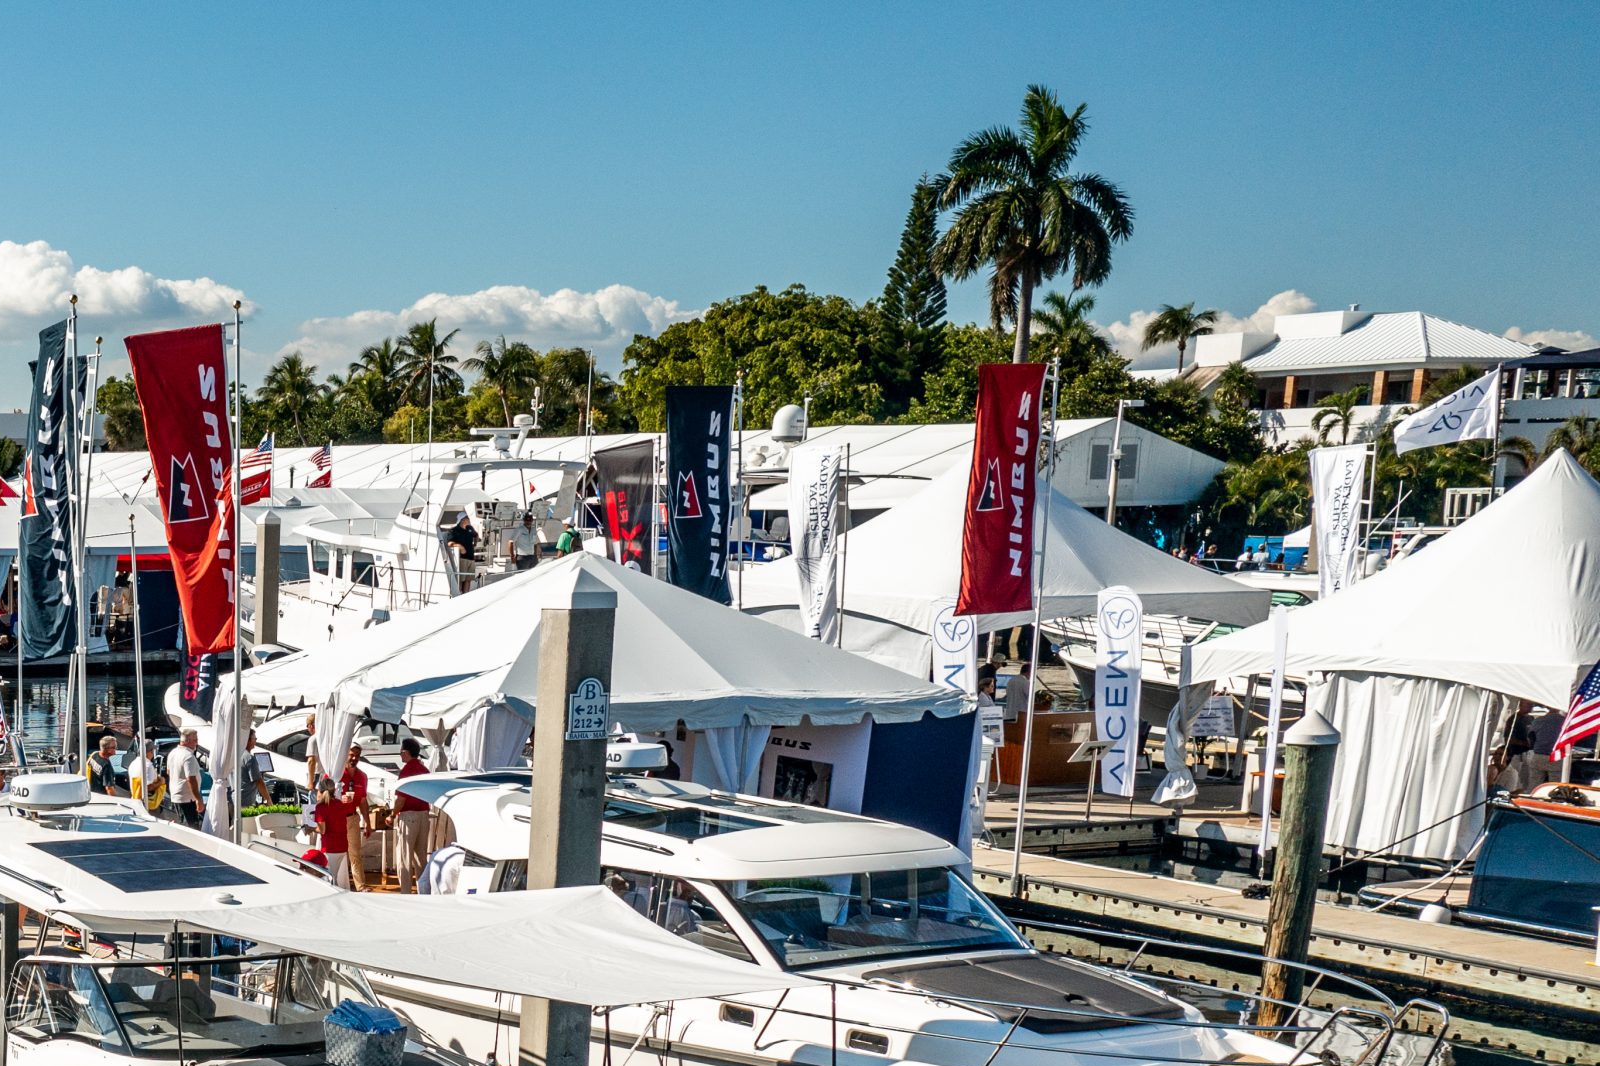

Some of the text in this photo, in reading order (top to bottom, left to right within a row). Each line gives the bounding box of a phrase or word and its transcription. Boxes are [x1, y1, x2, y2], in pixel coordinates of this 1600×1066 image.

[197, 364, 235, 604] NIMBUS
[706, 410, 722, 578] NIMBUS
[1009, 391, 1032, 578] NIMBUS
[809, 482, 819, 533] YACHTS
[1332, 486, 1342, 531] YACHTS
[184, 655, 201, 701] OATS
[584, 683, 596, 700] B
[573, 718, 593, 729] 212
[586, 704, 605, 715] 214
[569, 732, 589, 740] BAHIA
[767, 736, 812, 751] BUS
[10, 787, 30, 798] RAD
